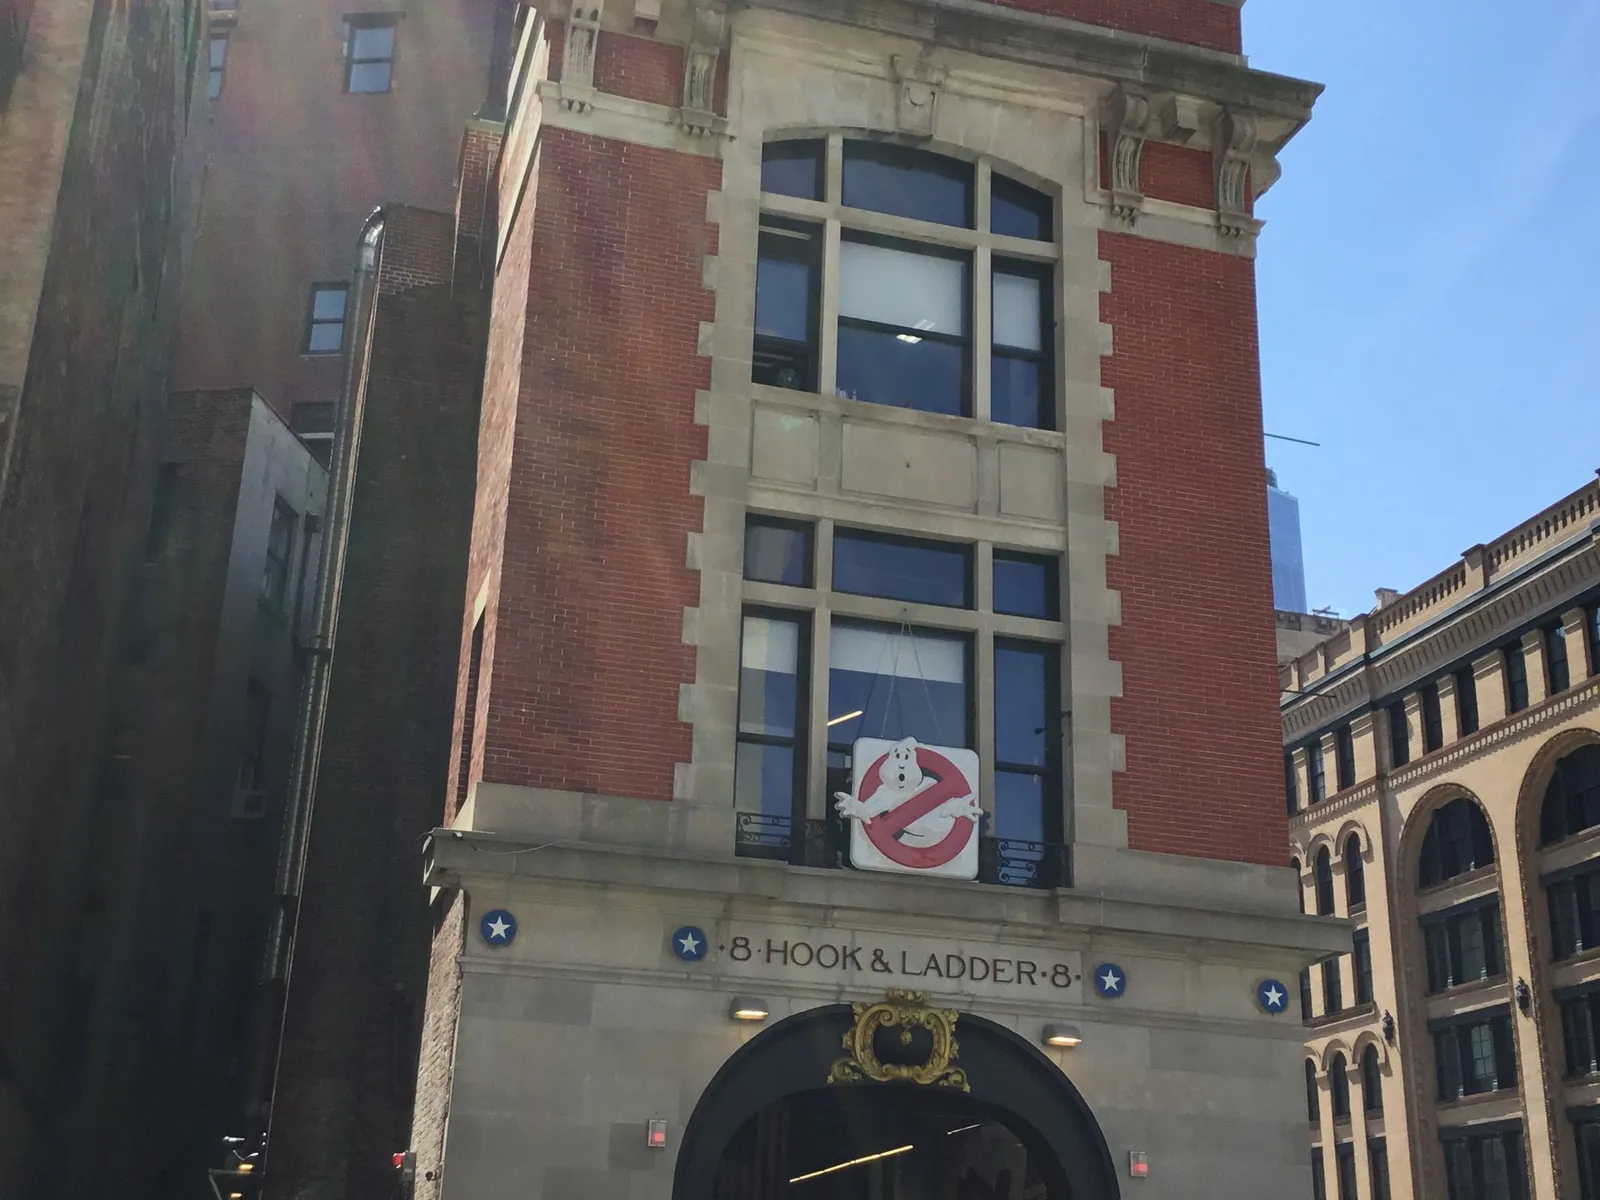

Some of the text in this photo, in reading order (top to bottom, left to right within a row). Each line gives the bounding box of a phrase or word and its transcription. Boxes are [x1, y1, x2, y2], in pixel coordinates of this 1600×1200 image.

[765, 938, 863, 970] HOOK
[871, 948, 893, 973] &
[901, 950, 1037, 986] LADDER
